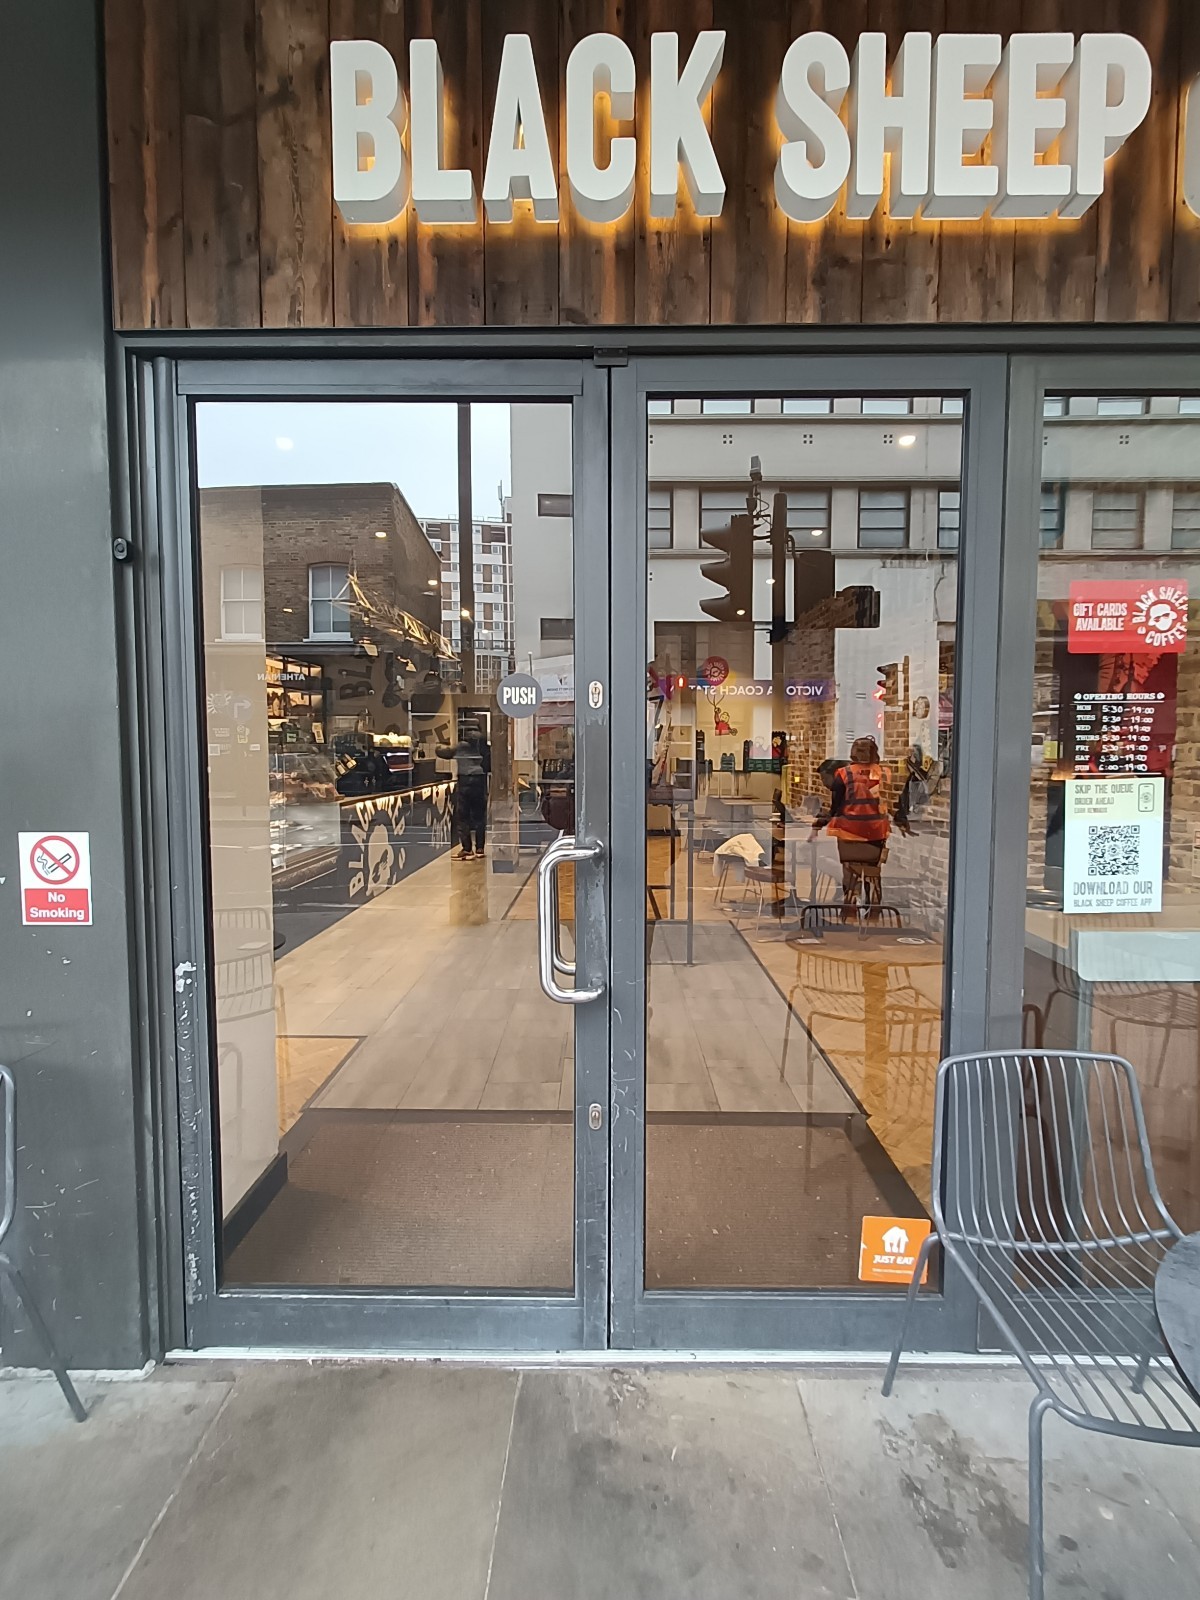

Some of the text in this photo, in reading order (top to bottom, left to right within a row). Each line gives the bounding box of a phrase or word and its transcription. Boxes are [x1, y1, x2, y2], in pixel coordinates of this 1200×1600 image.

[330, 31, 727, 223] BLACK
[774, 31, 1153, 221] SHEEP
[1073, 602, 1128, 617] GIFT CARDS
[1132, 586, 1188, 623] BLACK SHEEP
[1075, 617, 1125, 631] AVAILABLE
[1145, 621, 1188, 647] COFFEE
[503, 686, 536, 705] PUSH
[1074, 783, 1134, 794] SKIP THE QUEUE
[1073, 880, 1153, 896] DOWNLOAD OUR
[47, 891, 66, 903] No
[29, 907, 85, 920] Smoking
[873, 1254, 914, 1265] JUST EAT
